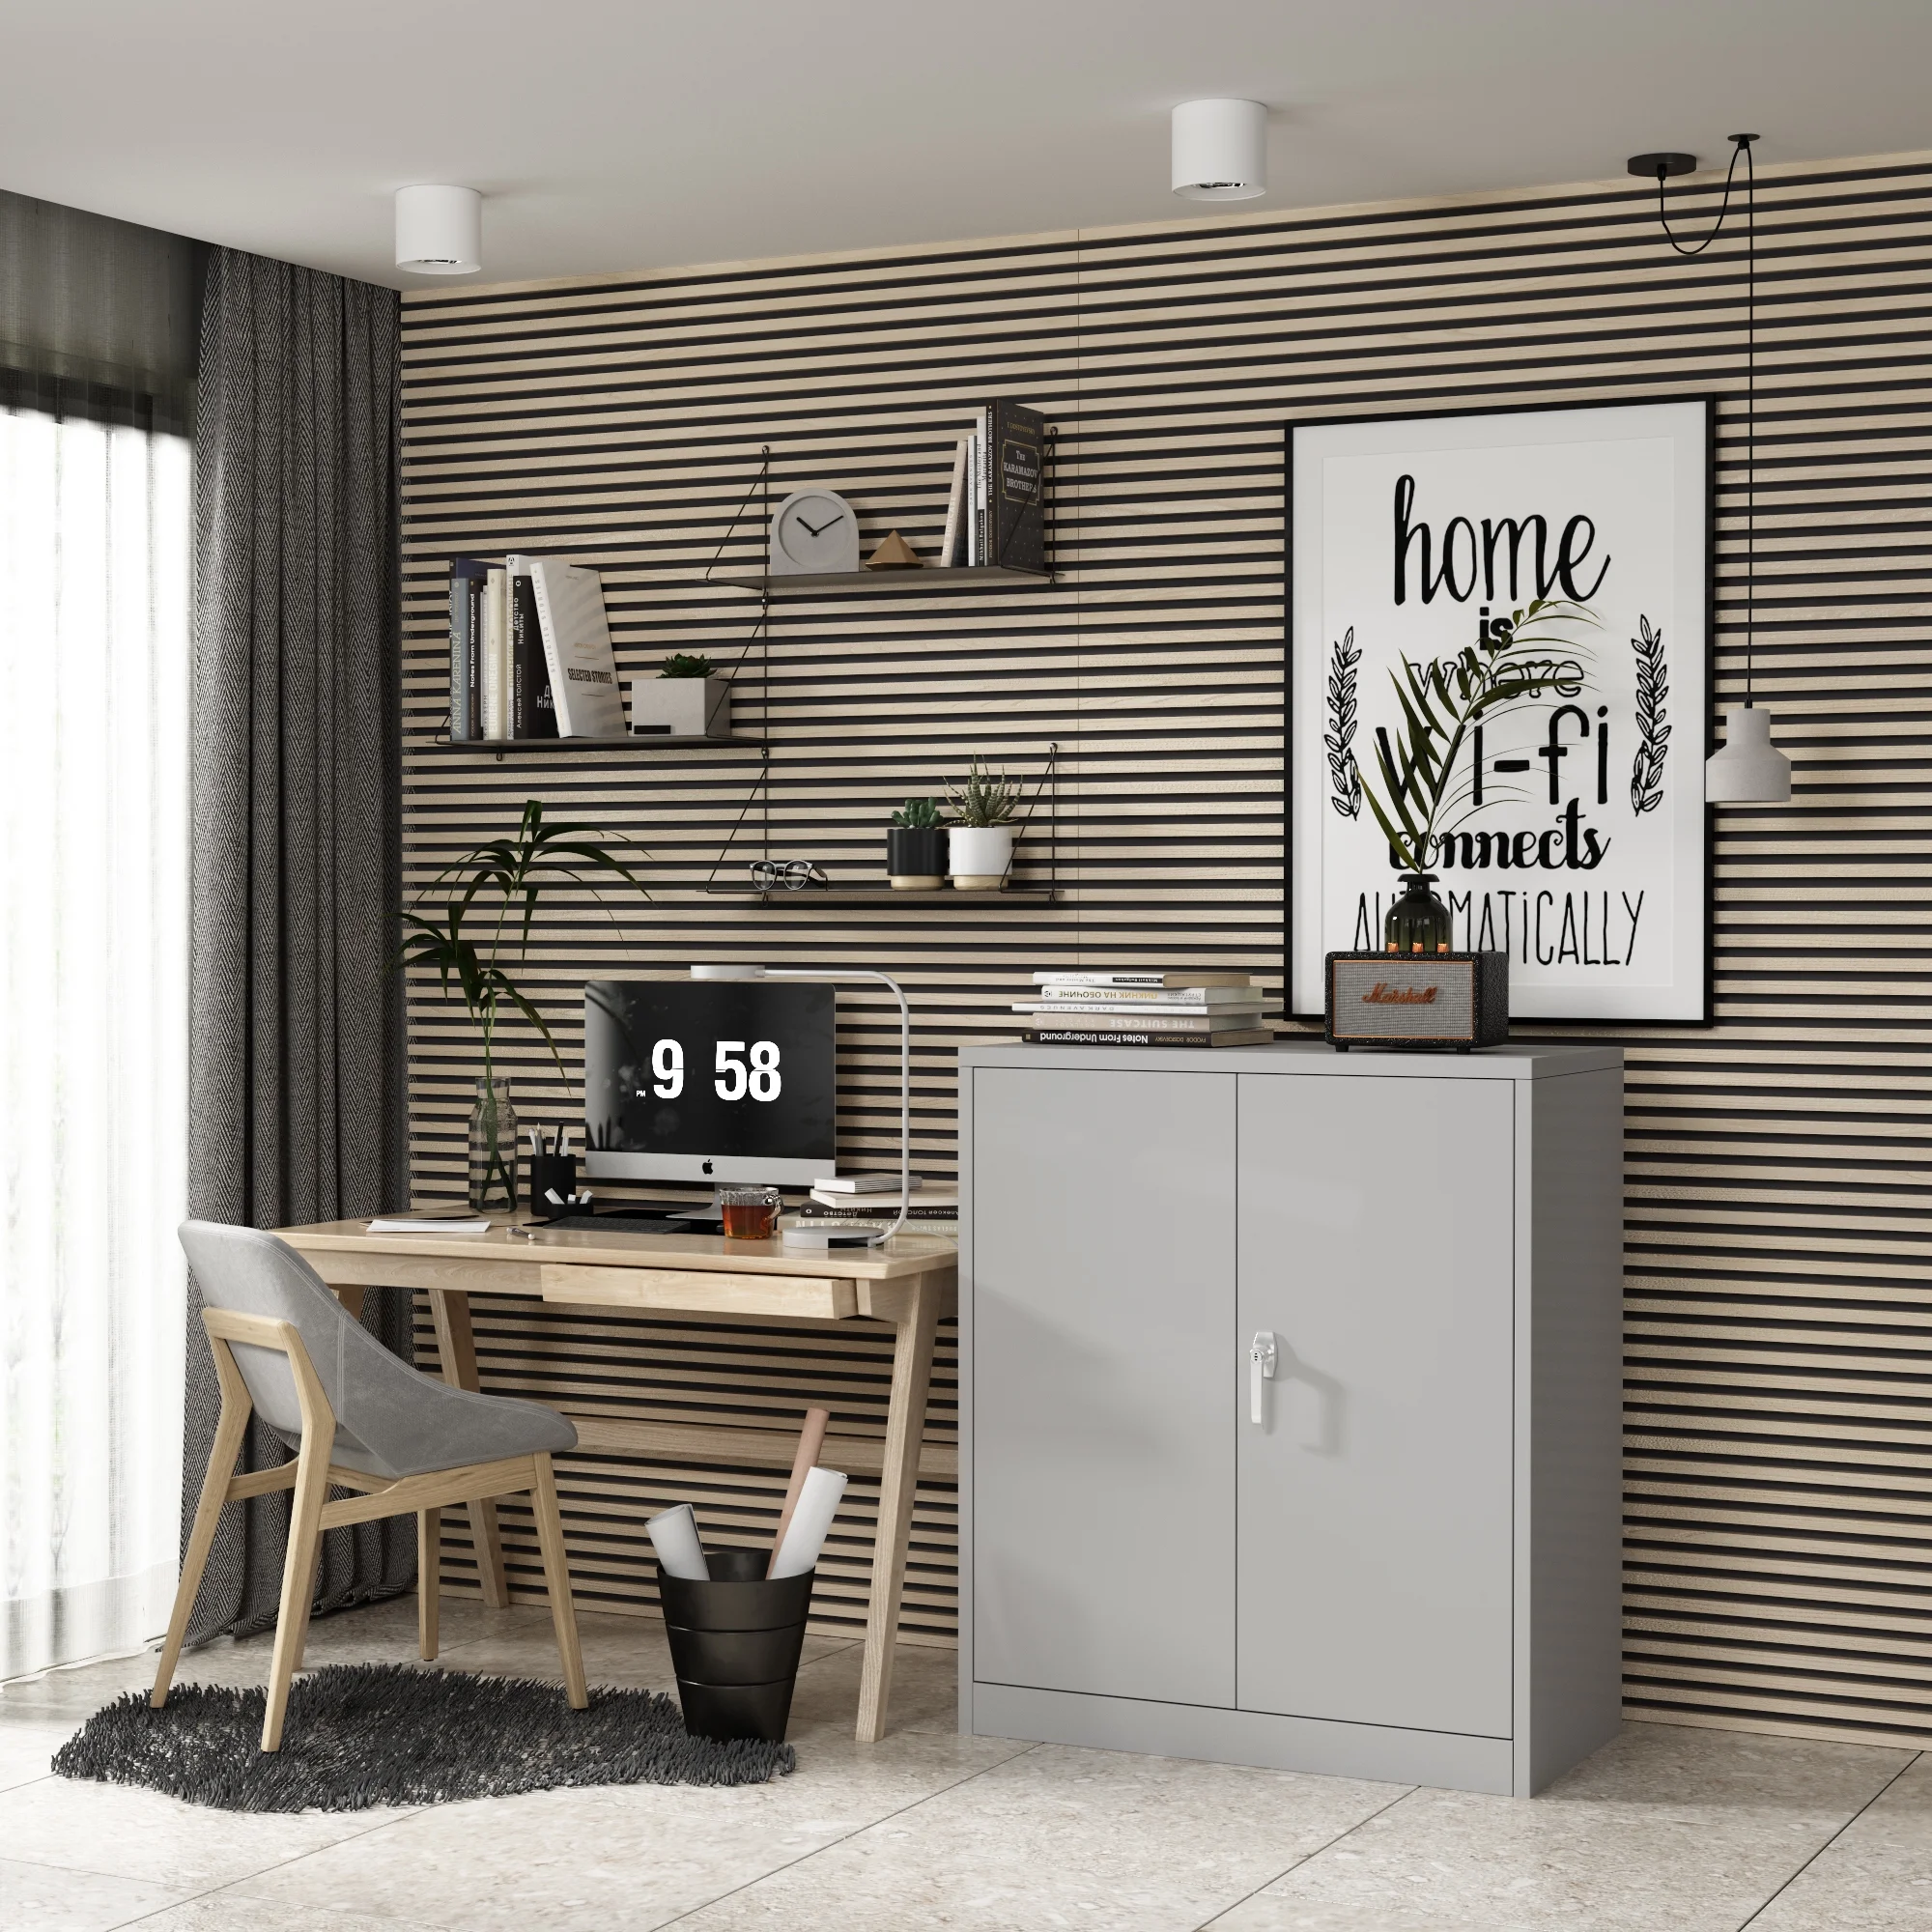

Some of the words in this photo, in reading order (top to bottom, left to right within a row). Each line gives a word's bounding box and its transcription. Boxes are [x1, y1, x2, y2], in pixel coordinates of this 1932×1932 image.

[945, 497, 956, 537] SUITCASE
[943, 540, 952, 556] THE
[1394, 474, 1611, 606] home
[1479, 607, 1514, 650] is
[452, 632, 462, 694] KARENINA
[488, 653, 497, 692] ONEGIN
[567, 668, 591, 682] SELECTED
[592, 669, 613, 685] STORIES
[452, 697, 462, 734] ANNA
[488, 694, 497, 732] EUGENE
[1389, 798, 1611, 870] connects
[1059, 990, 1101, 999] ОБОЧИНЕ
[1362, 982, 1437, 1005] Marshall
[1040, 1031, 1097, 1043] Underground
[1098, 1034, 1122, 1043] From
[1110, 1019, 1168, 1029] SUITCASE
[1172, 1019, 1195, 1029] THE
[1122, 1035, 1149, 1044] Notes
[651, 1038, 684, 1099] 9
[714, 1040, 781, 1102] 58
